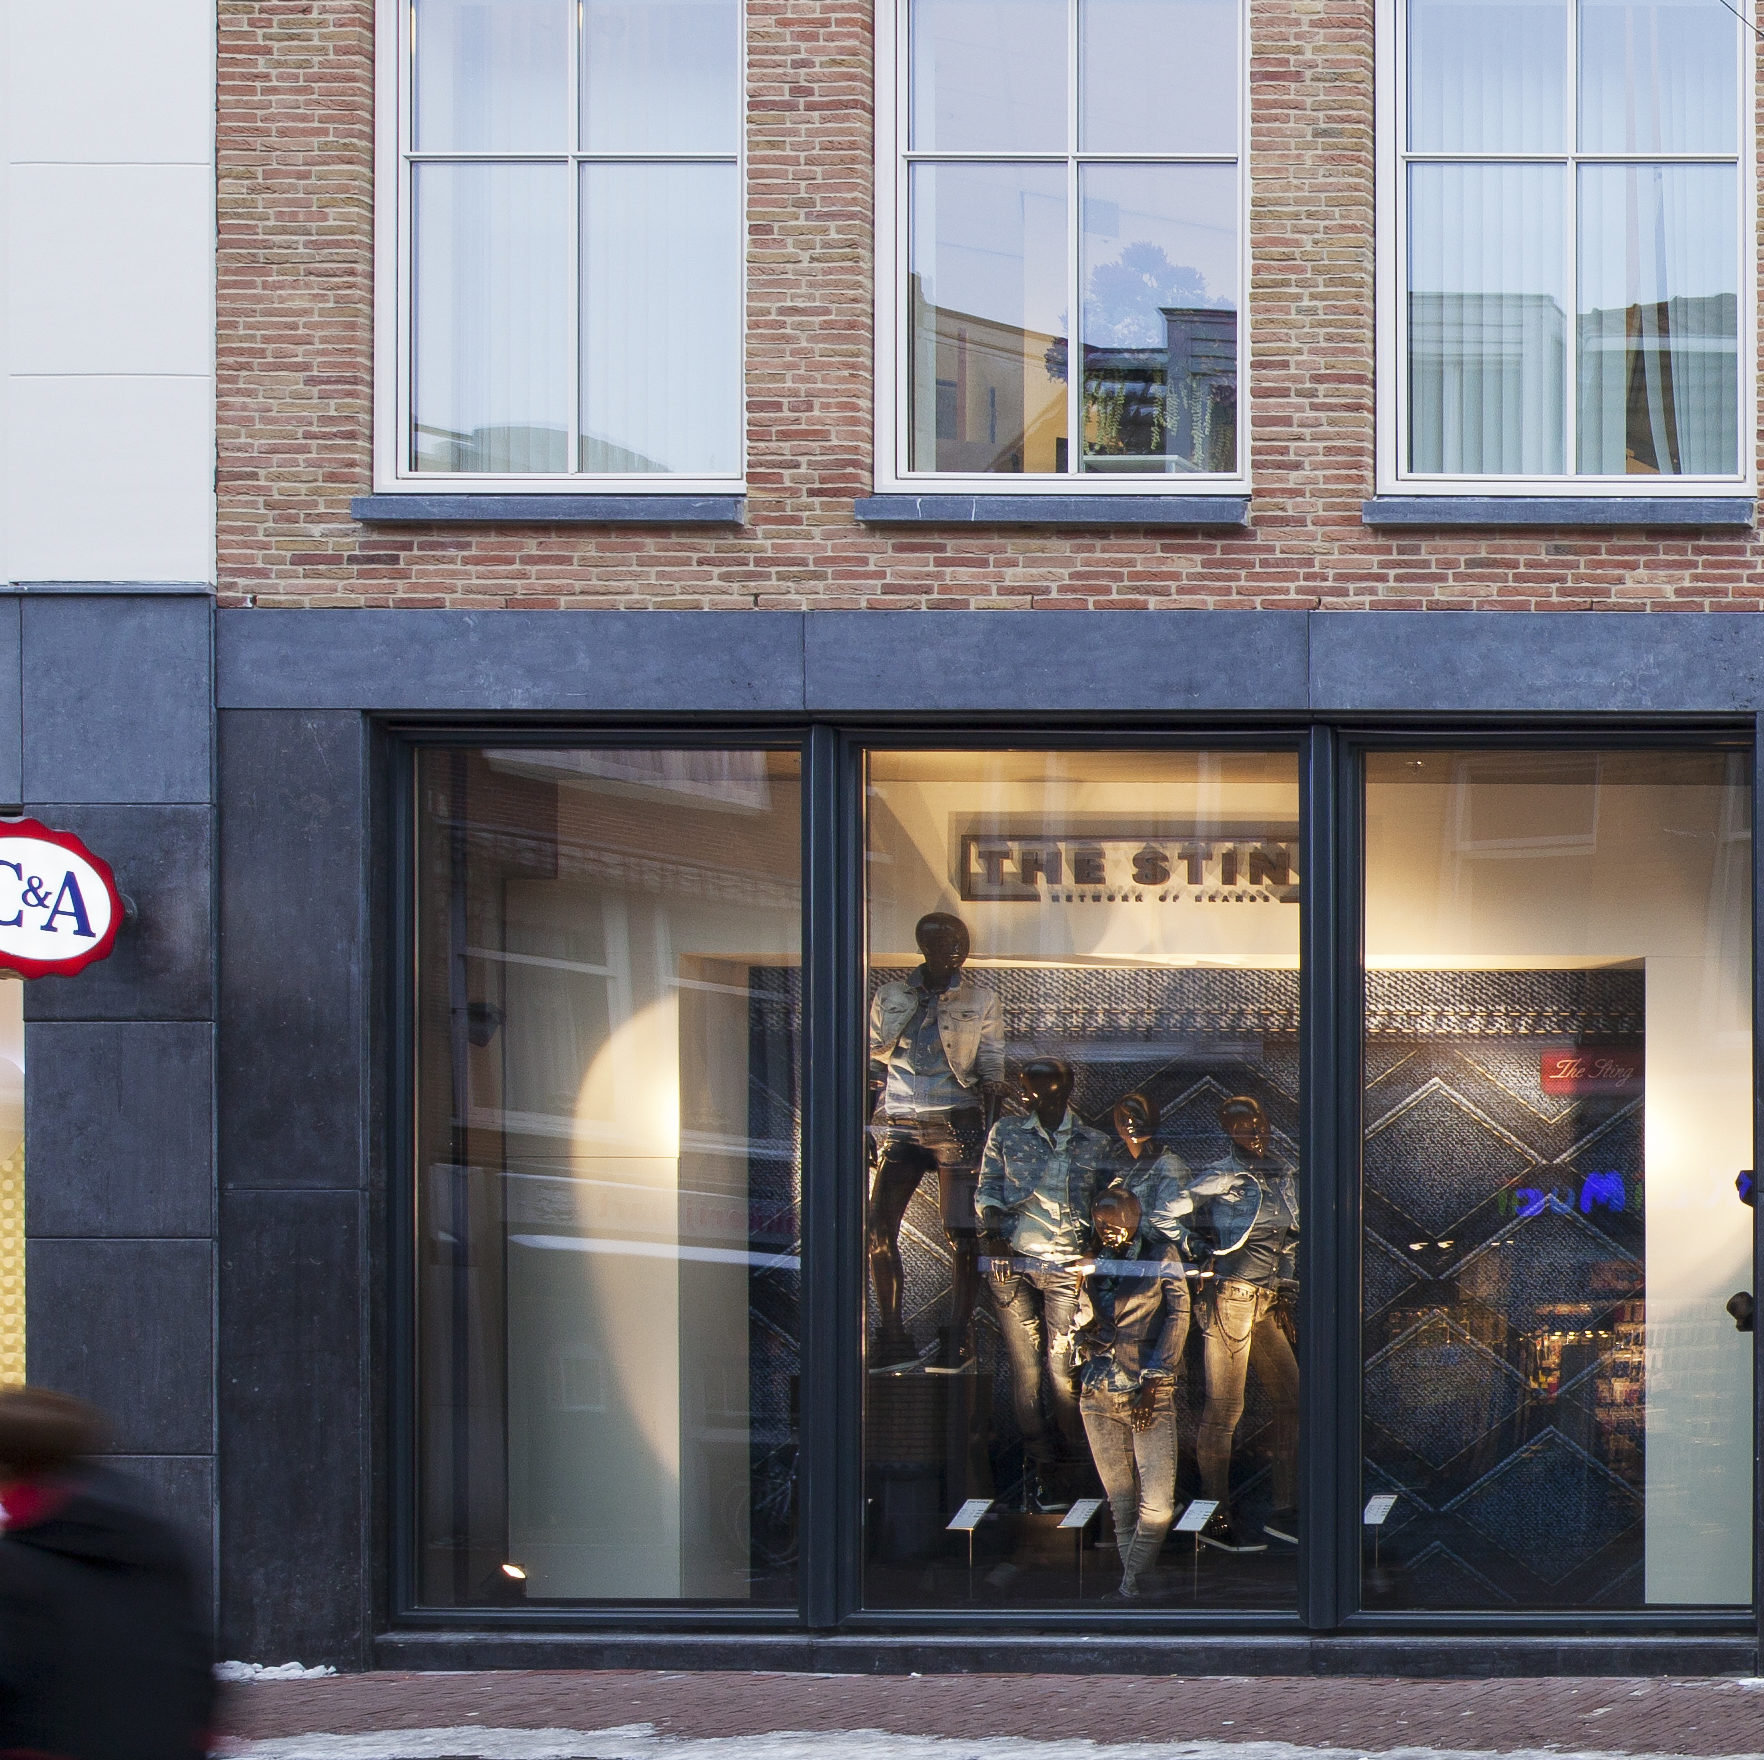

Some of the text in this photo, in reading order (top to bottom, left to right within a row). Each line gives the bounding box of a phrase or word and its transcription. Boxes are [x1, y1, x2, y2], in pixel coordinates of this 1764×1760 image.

[977, 849, 1291, 886] THE STIN
[1549, 1058, 1586, 1079] The
